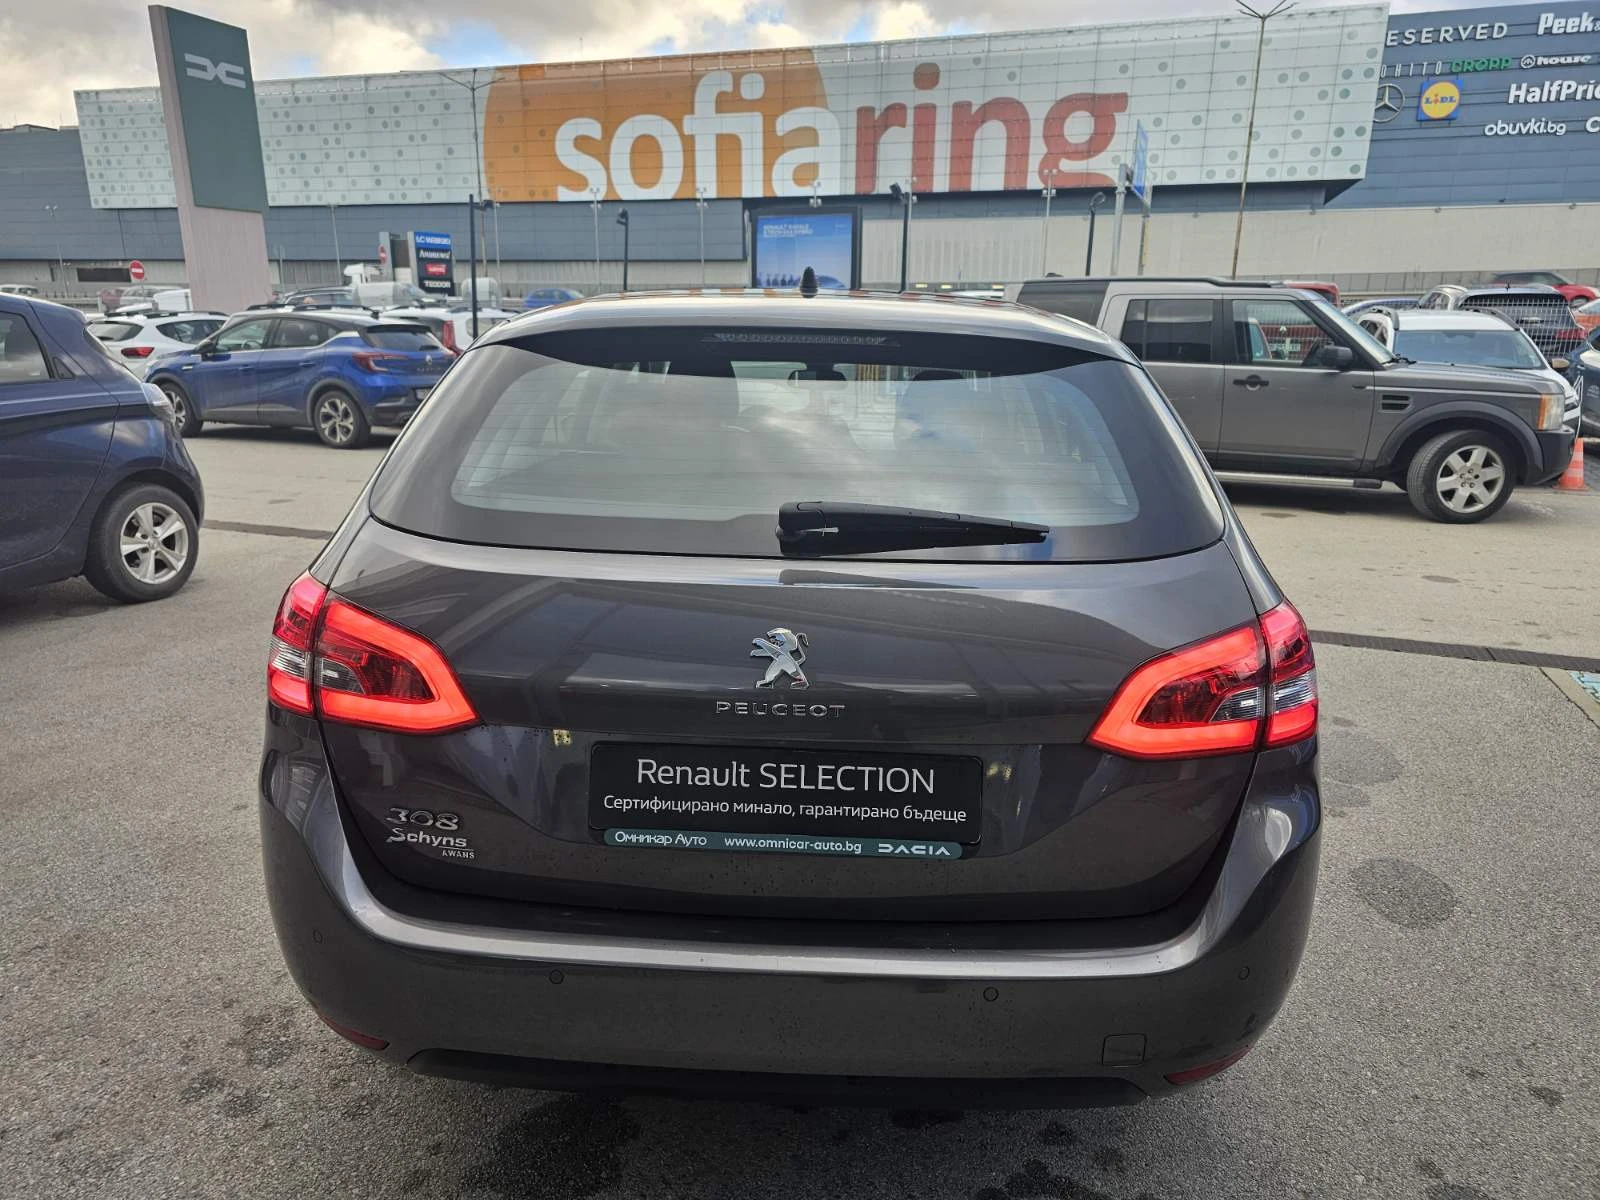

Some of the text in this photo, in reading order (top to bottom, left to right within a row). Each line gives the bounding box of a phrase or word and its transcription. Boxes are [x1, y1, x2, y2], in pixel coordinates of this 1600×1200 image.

[1451, 57, 1513, 73] CROPP
[1484, 118, 1566, 136] obuvki.bg
[715, 700, 846, 718] PEUGEOT
[637, 759, 935, 794] Renault SELECTION
[603, 795, 967, 823] Сертифицирано минало, гарантирано бъдеще
[386, 807, 458, 831] 308
[386, 827, 467, 847] Schyns
[614, 831, 707, 847] Омникар Ауто
[724, 837, 863, 854] www.omnicar-auto.bg
[442, 850, 475, 859] AWANS
